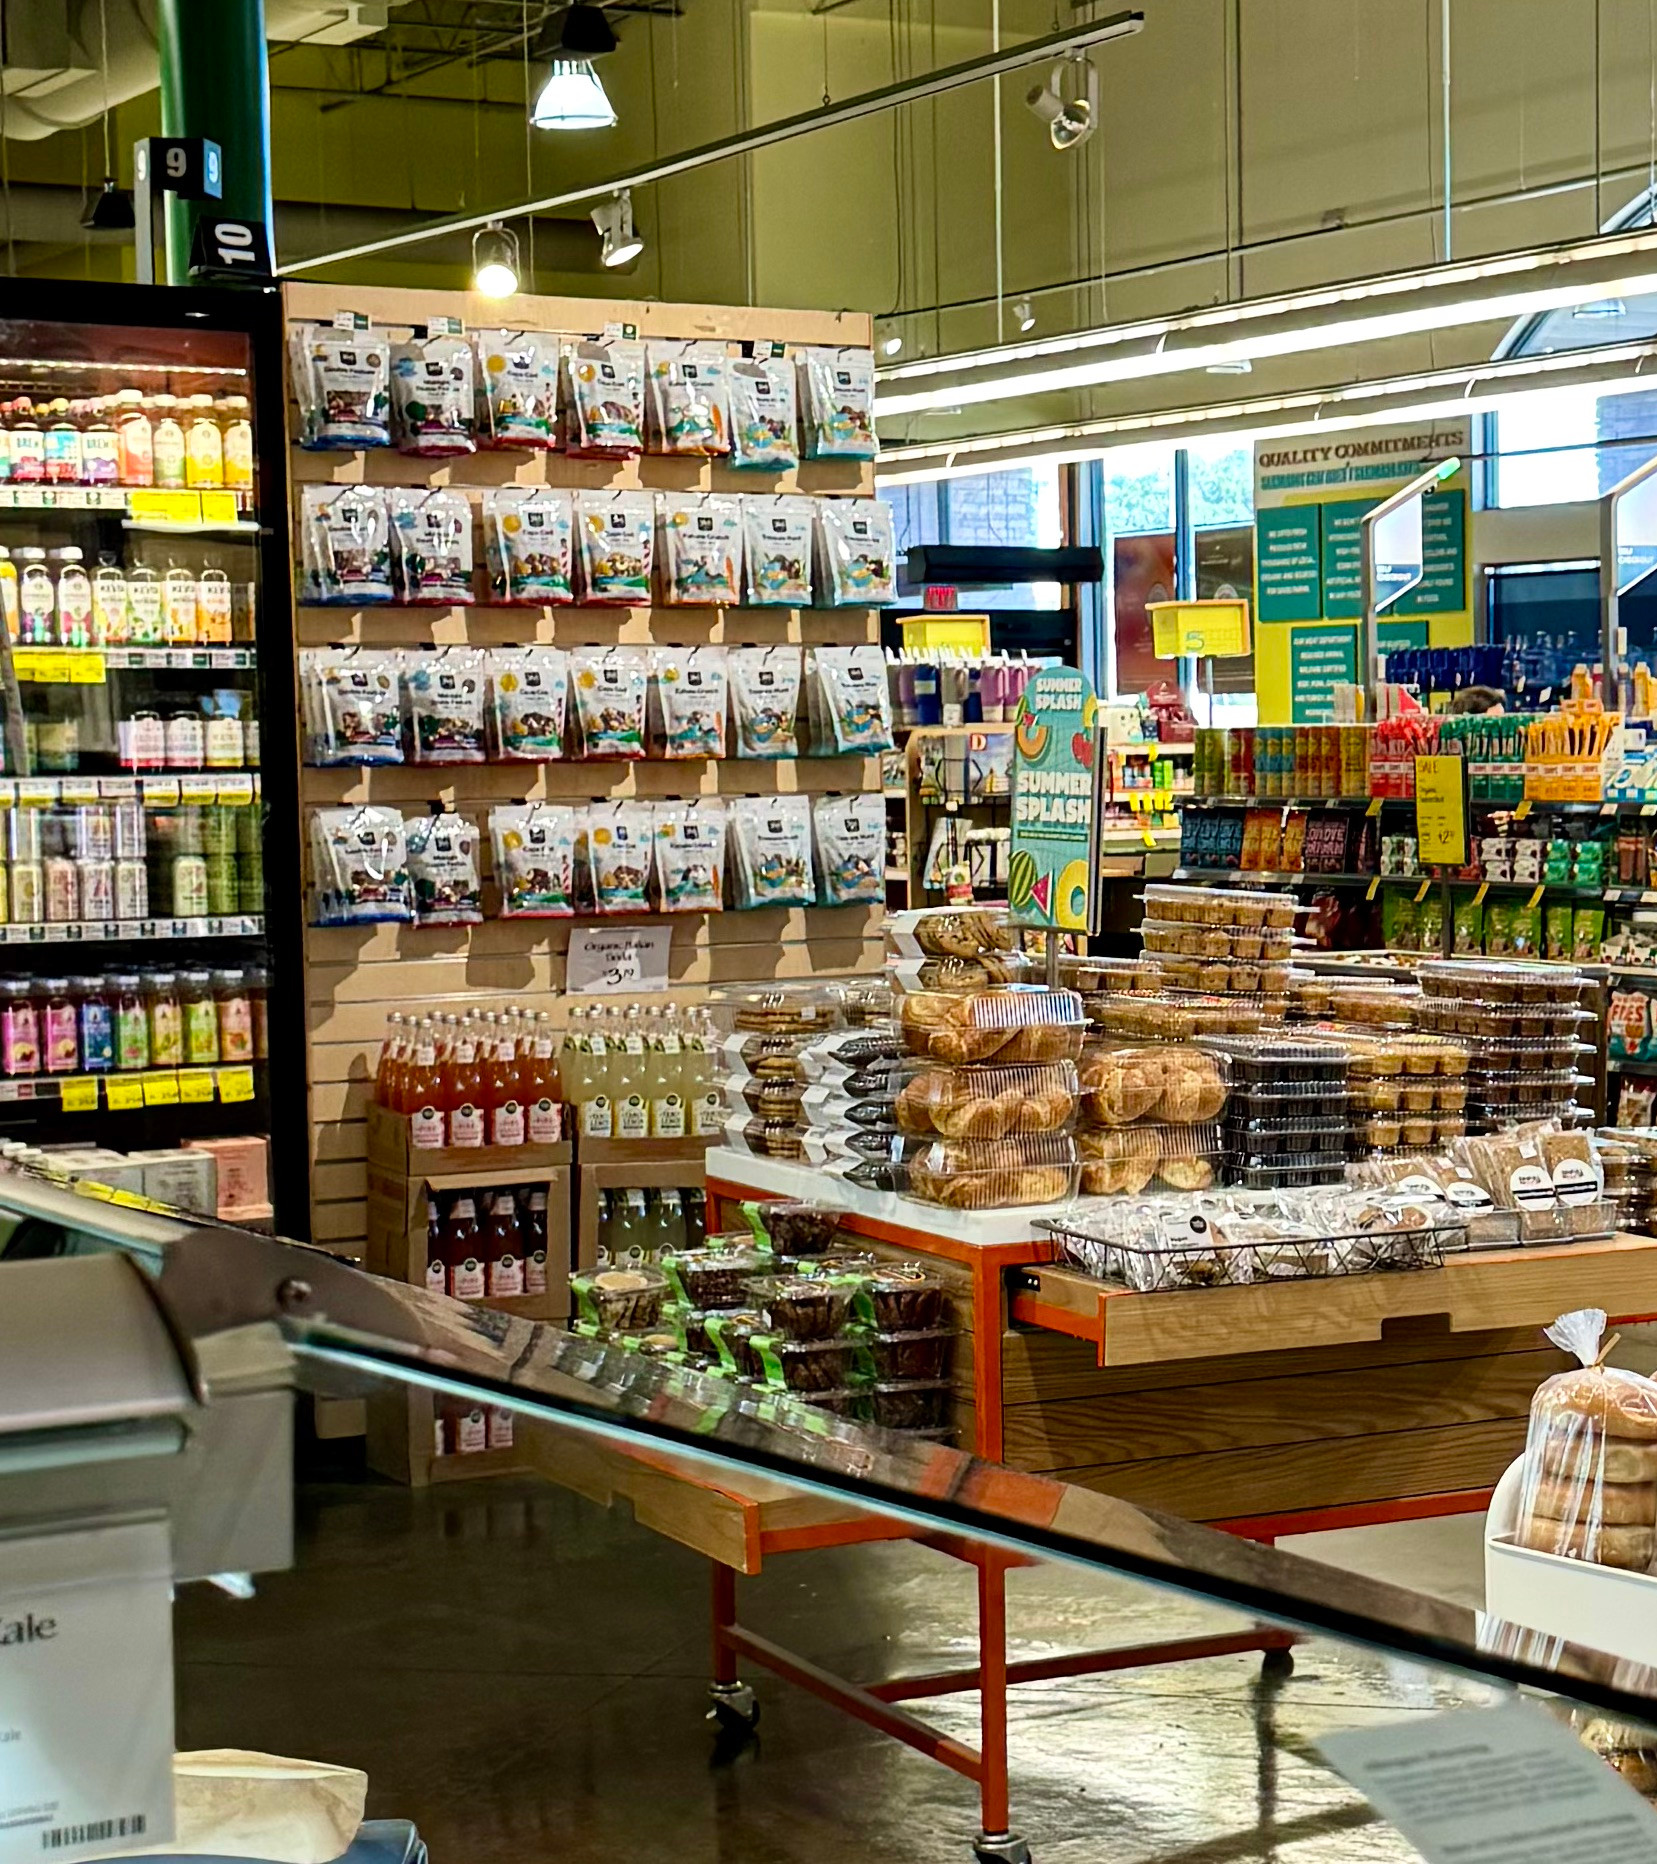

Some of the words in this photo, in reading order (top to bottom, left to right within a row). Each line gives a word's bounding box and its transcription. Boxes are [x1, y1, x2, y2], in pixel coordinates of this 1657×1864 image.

[137, 150, 147, 181] 9
[166, 147, 187, 178] 9
[208, 151, 219, 184] 9
[214, 223, 256, 265] 10
[1259, 445, 1332, 468] QUALITY
[1334, 431, 1464, 459] COMMITMENTS
[1036, 677, 1082, 693] SUMMER
[1035, 693, 1082, 711] SPLASH
[1017, 771, 1092, 795] SUMMER
[1016, 797, 1091, 825] SPLASH
